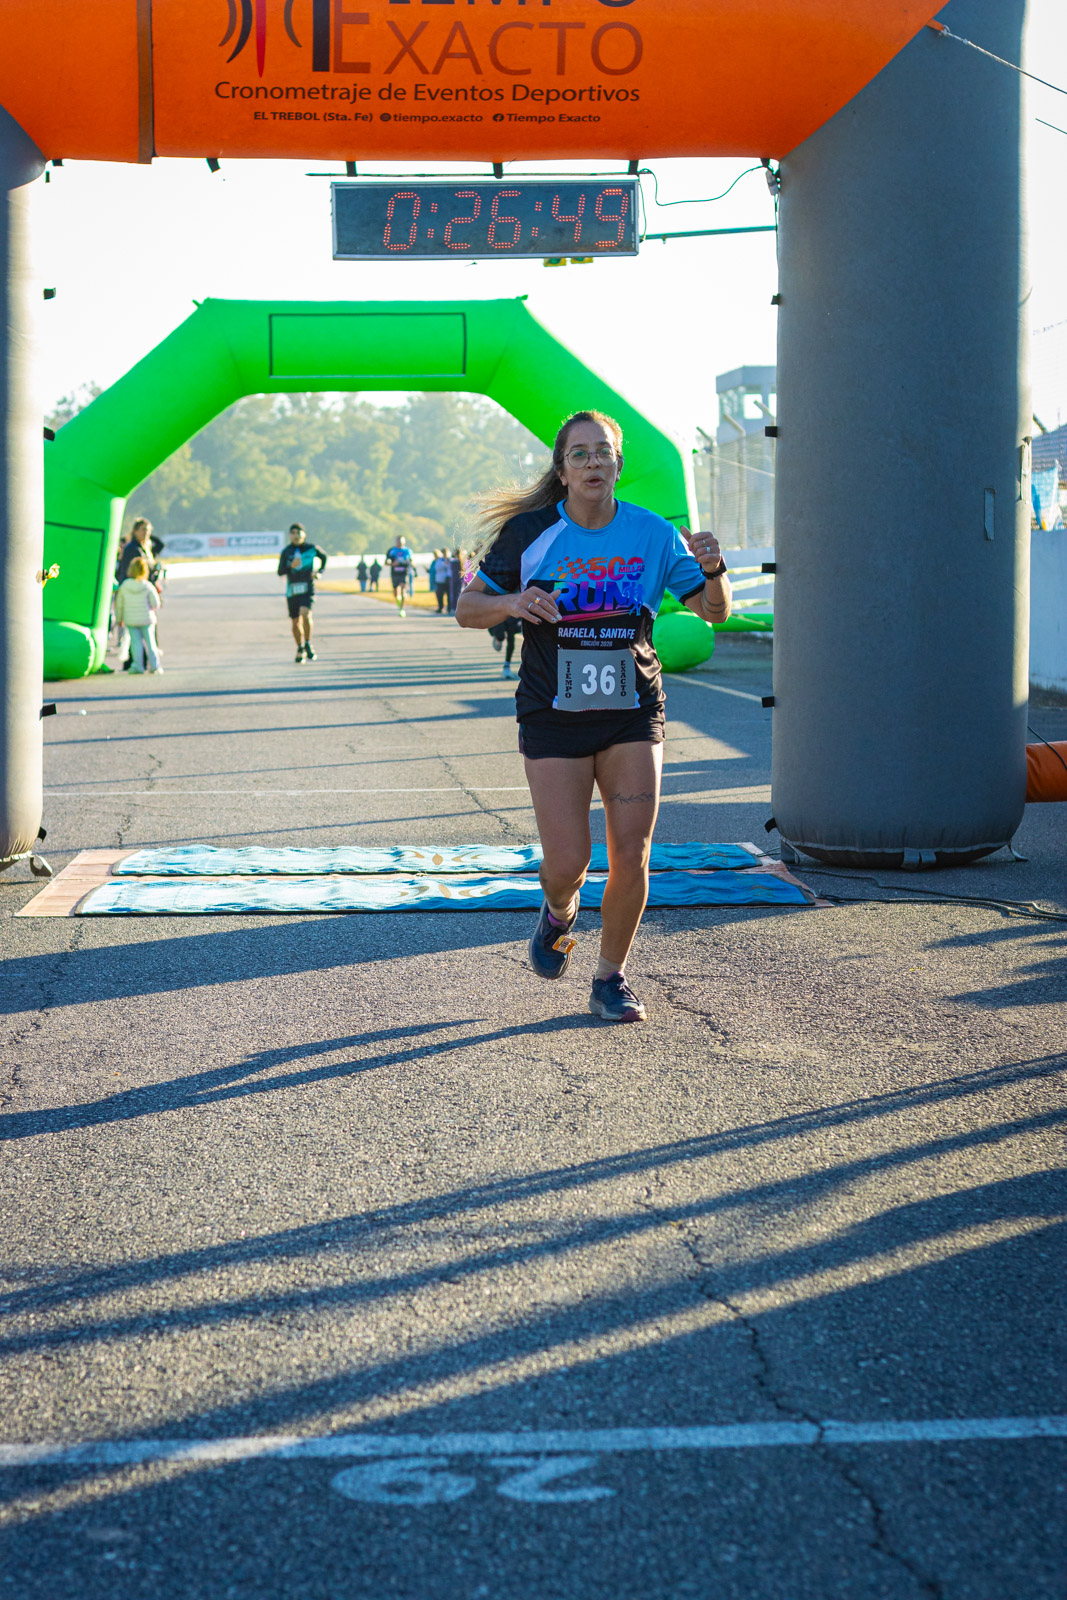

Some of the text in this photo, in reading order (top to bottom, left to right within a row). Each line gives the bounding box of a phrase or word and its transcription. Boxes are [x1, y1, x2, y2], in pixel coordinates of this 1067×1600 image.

[215, 81, 640, 105] Cronometraje de Eventos Deportivos
[253, 111, 373, 122] EL TREBOL (Sta. Fe)
[393, 113, 483, 124] tiempo.exacto
[506, 113, 601, 124] Tiempo Exacto
[383, 188, 629, 250] 0:26:49
[587, 556, 644, 581] 500
[619, 564, 645, 574] MILLAS
[554, 581, 633, 612] RUN
[558, 627, 598, 639] RAFAELA,
[565, 661, 573, 699] TIEMPO
[581, 663, 616, 695] 36
